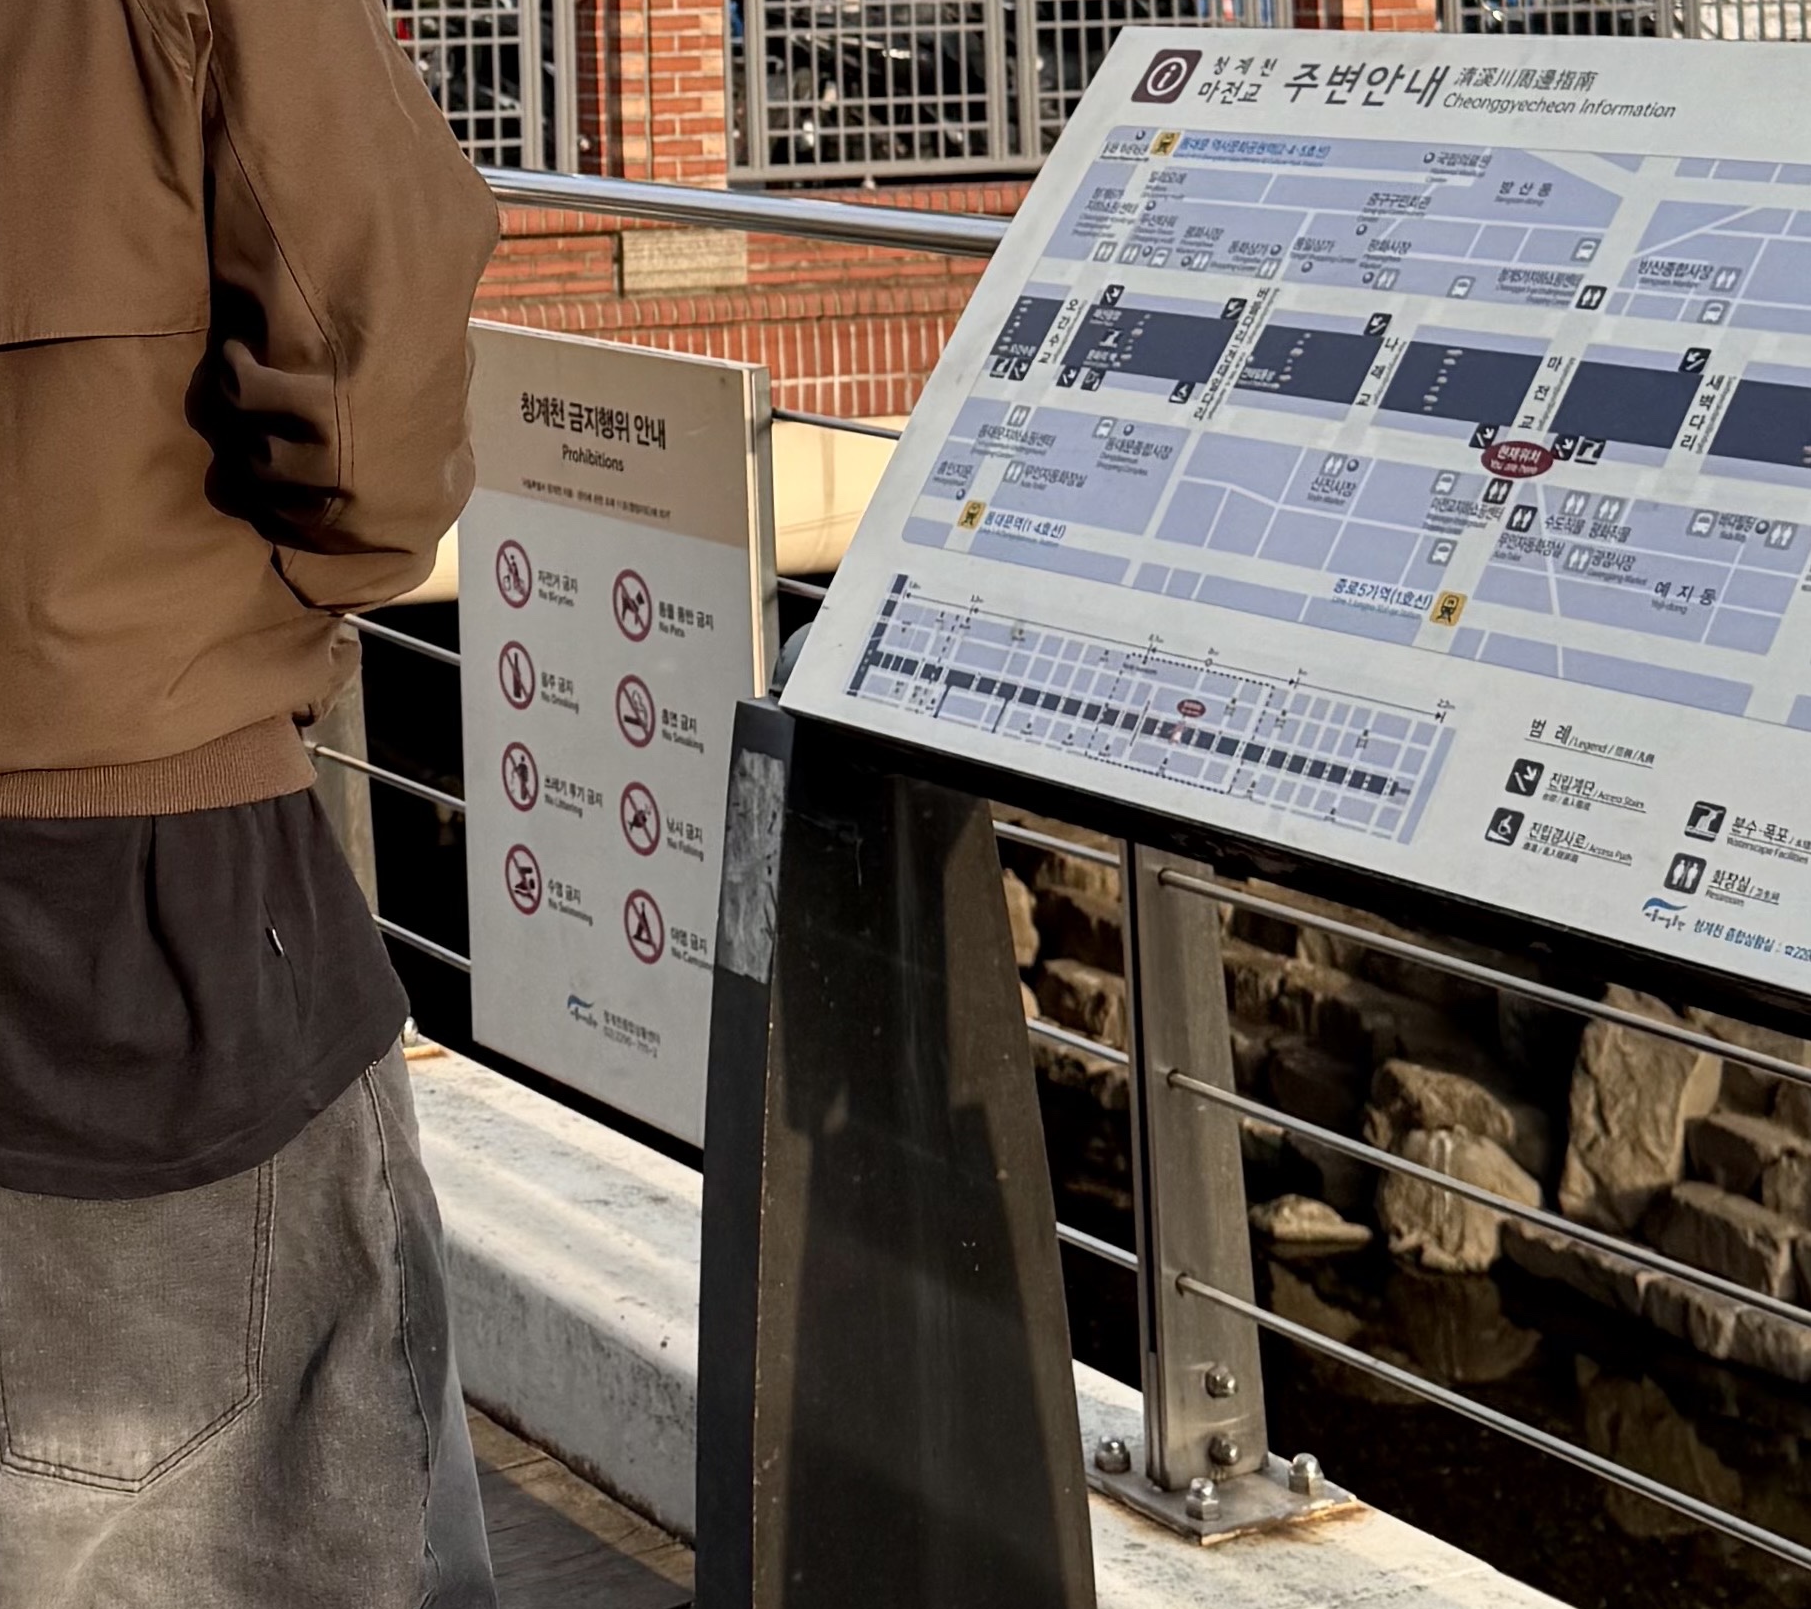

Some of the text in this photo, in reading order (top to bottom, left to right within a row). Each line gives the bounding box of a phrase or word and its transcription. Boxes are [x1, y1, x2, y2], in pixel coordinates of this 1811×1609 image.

[1213, 56, 1278, 78] 청계천
[1198, 80, 1261, 105] 마전교
[1284, 62, 1451, 109] 주변안내
[1442, 92, 1677, 119] Cheonggyecheon Information
[1517, 354, 1564, 431] 마전교
[520, 391, 667, 451] 청계천 금지행위 안내
[1678, 373, 1727, 452] 새벽다리
[561, 443, 625, 472] Prohibitions
[538, 569, 579, 594] 자전거 금지
[1653, 581, 1717, 607] 예지동
[696, 611, 715, 632] 금지
[680, 714, 697, 735] 금지
[587, 788, 604, 808] 금지
[686, 822, 703, 844] 금지
[1710, 869, 1752, 893] 화장실
[565, 884, 582, 906] 금지
[690, 932, 708, 955] 금지
